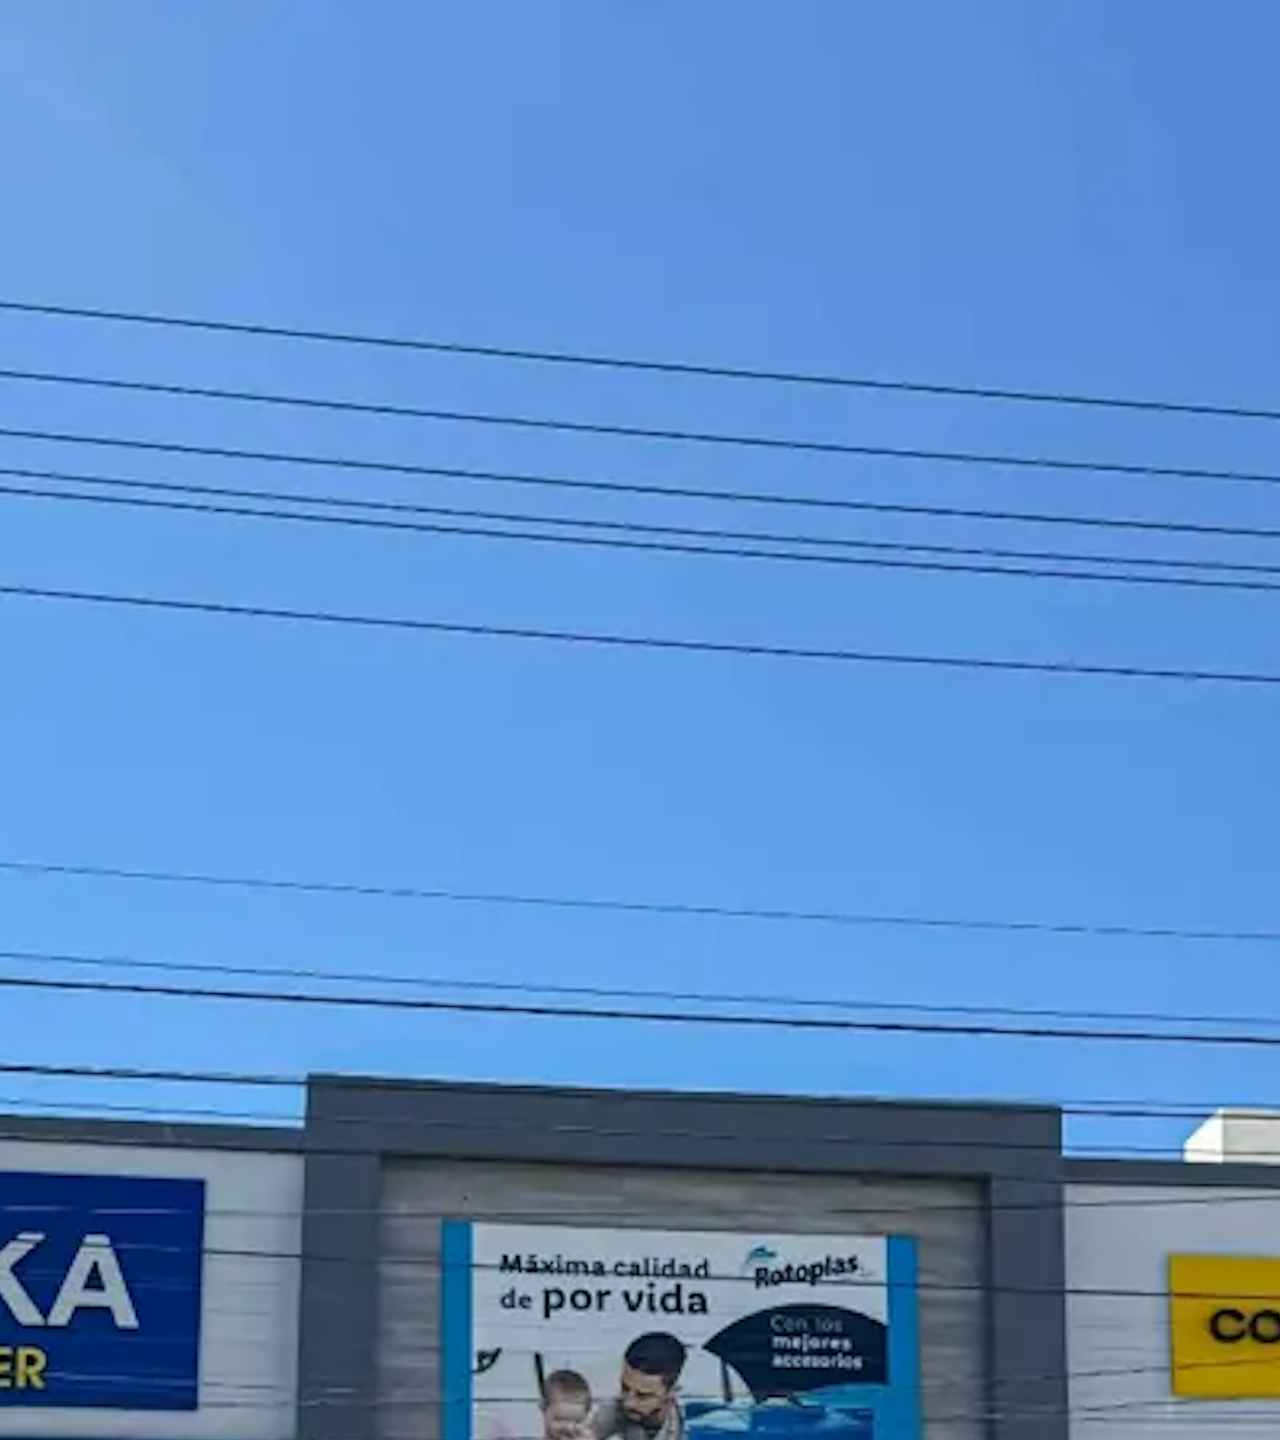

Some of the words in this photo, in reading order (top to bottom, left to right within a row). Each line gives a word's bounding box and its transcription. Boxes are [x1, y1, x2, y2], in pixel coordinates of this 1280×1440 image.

[499, 1253, 606, 1279] Máxima
[613, 1256, 711, 1281] calidad
[754, 1253, 859, 1290] Rotoplas
[500, 1288, 533, 1311] de
[542, 1284, 613, 1319] por
[623, 1282, 710, 1315] vida
[772, 1333, 853, 1353] mejores
